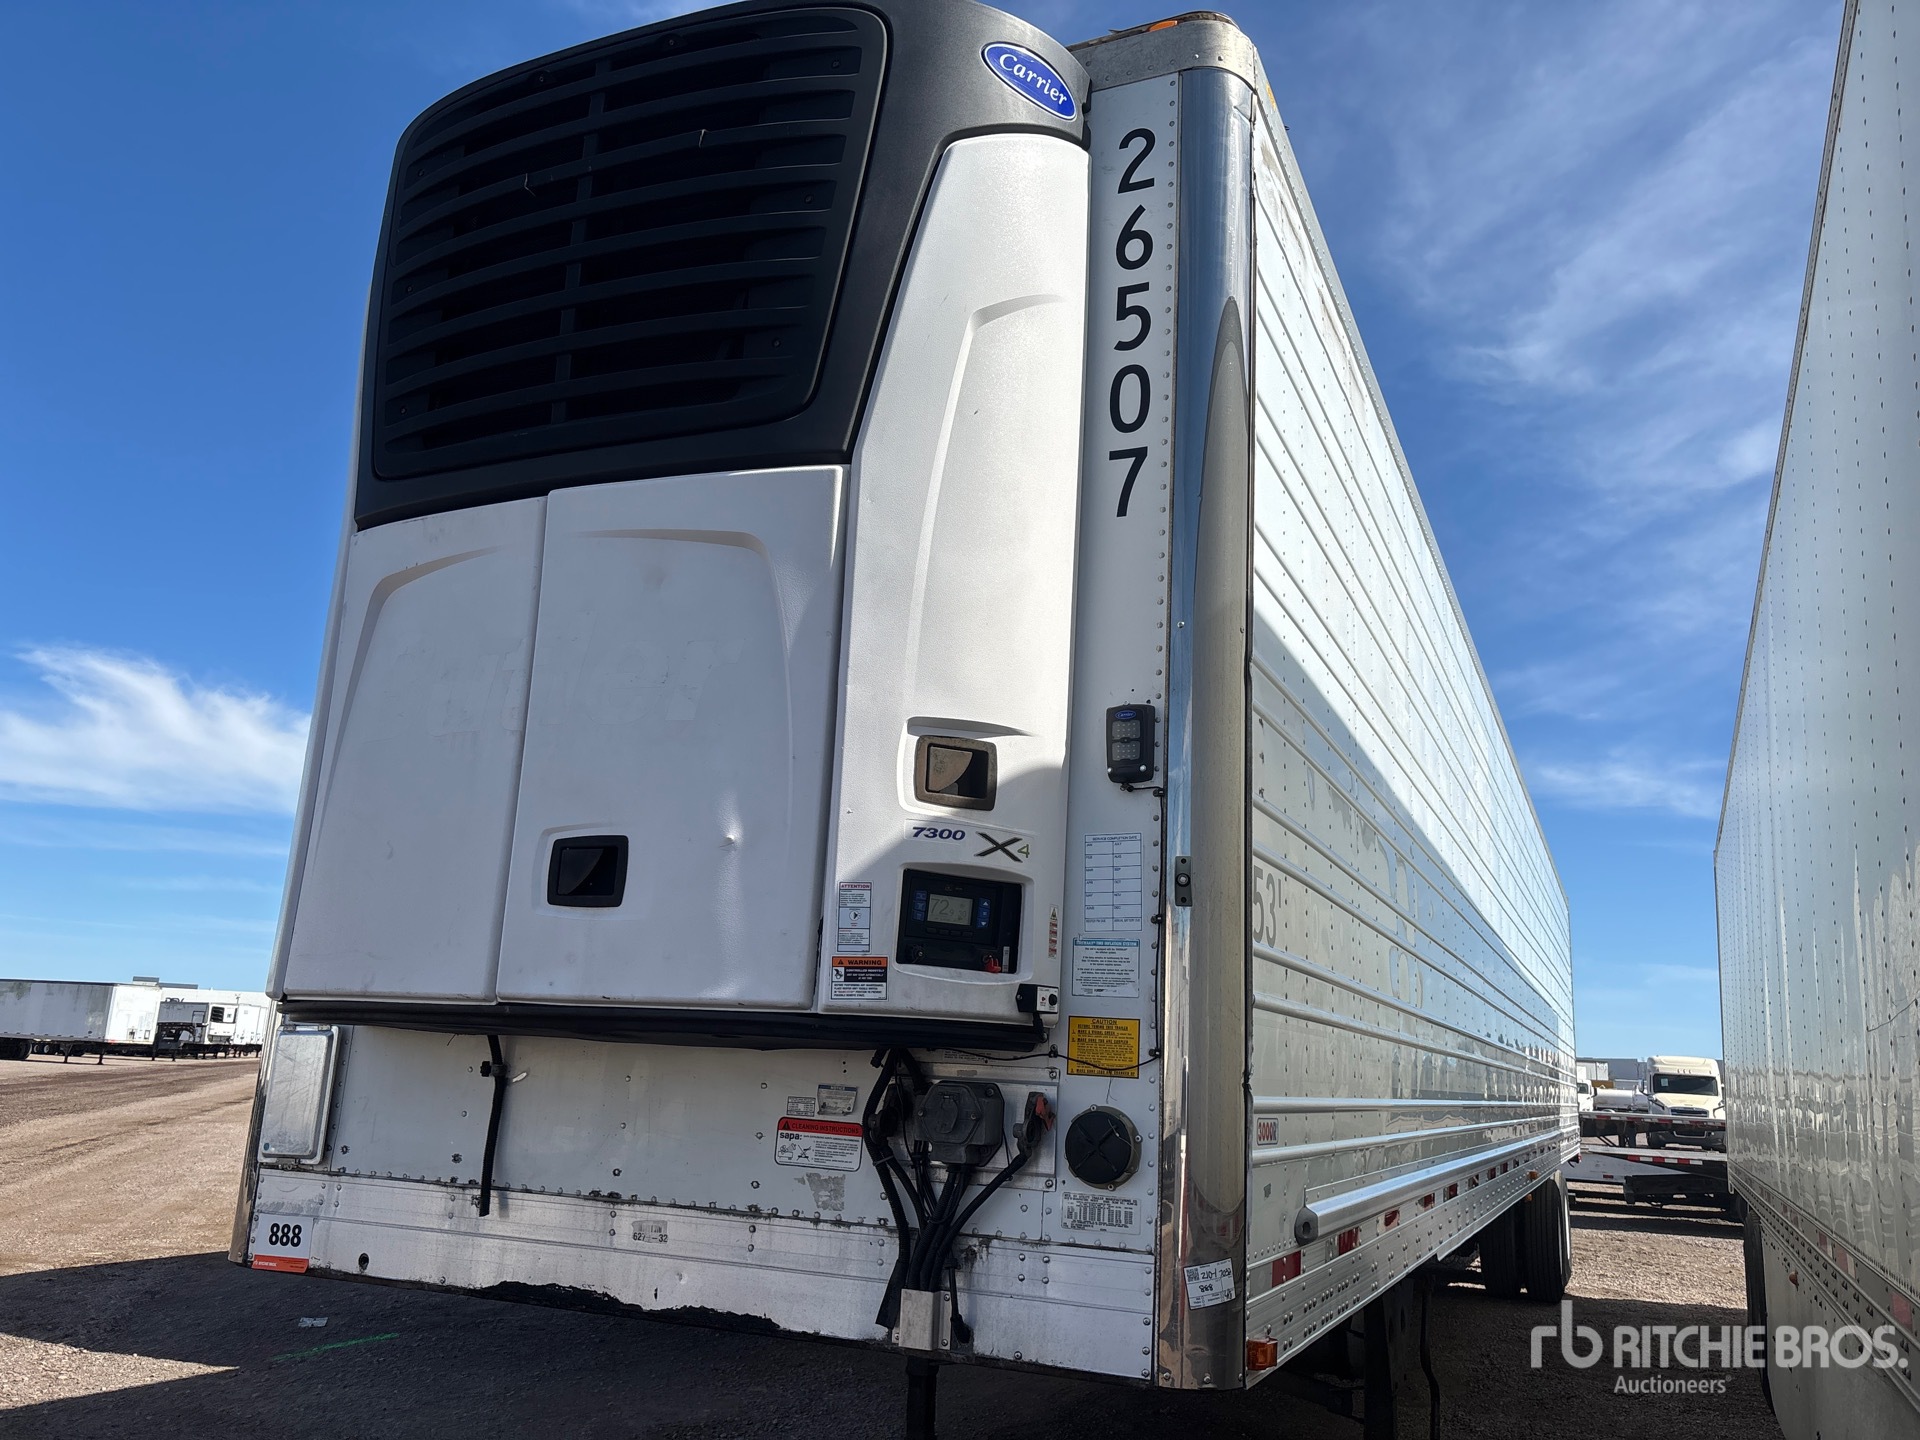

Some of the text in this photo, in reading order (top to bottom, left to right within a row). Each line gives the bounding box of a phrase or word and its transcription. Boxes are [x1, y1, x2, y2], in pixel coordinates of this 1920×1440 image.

[999, 53, 1068, 105] Carrier
[1108, 127, 1156, 518] 26507
[912, 826, 966, 841] 7300
[791, 1122, 859, 1134] CLEANING INSTRUCTIONS
[1258, 1121, 1277, 1141] 3000R
[268, 1222, 303, 1248] 888
